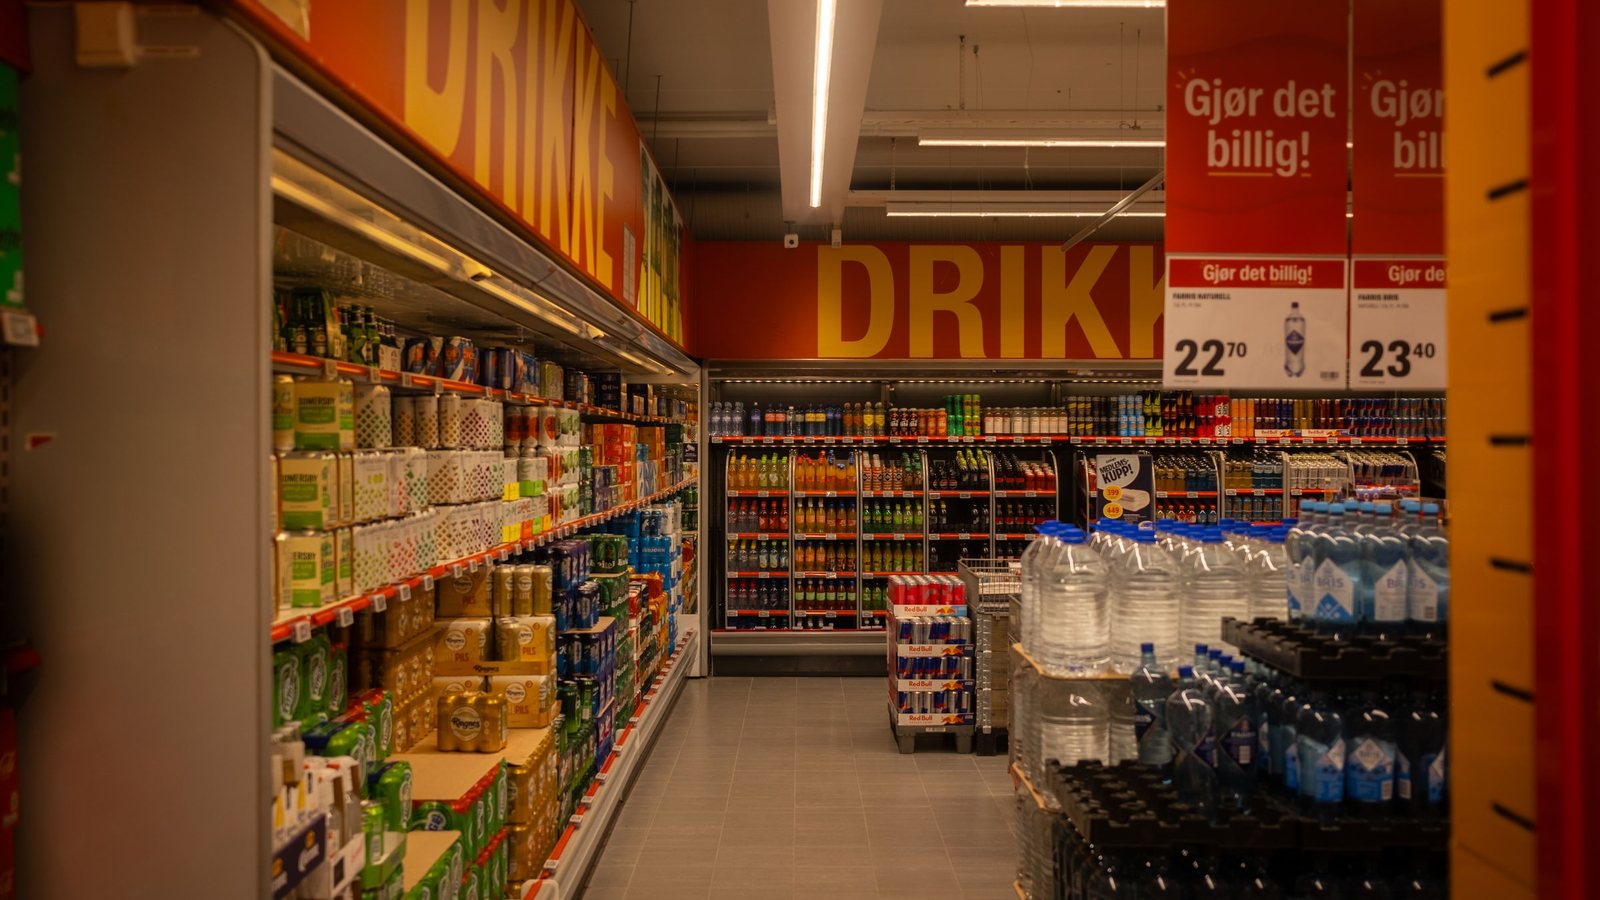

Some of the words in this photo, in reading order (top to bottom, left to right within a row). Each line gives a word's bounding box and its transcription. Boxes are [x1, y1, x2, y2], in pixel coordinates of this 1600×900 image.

[1184, 78, 1264, 125] Gjør
[1273, 80, 1336, 118] det
[404, 0, 616, 290] DRIKKE
[1207, 129, 1311, 178] billig!
[1203, 264, 1236, 285] Gjør
[1239, 264, 1266, 281] det
[1269, 265, 1313, 285] billig!
[1388, 265, 1422, 286] Gjør
[1174, 339, 1225, 376] 22
[1227, 342, 1247, 357] 70
[1360, 340, 1411, 377] 23
[1413, 343, 1435, 358] 40
[1099, 458, 1129, 474] MEDLEMS-
[1102, 463, 1134, 484] KUPP!
[450, 717, 480, 729] Ringnes
